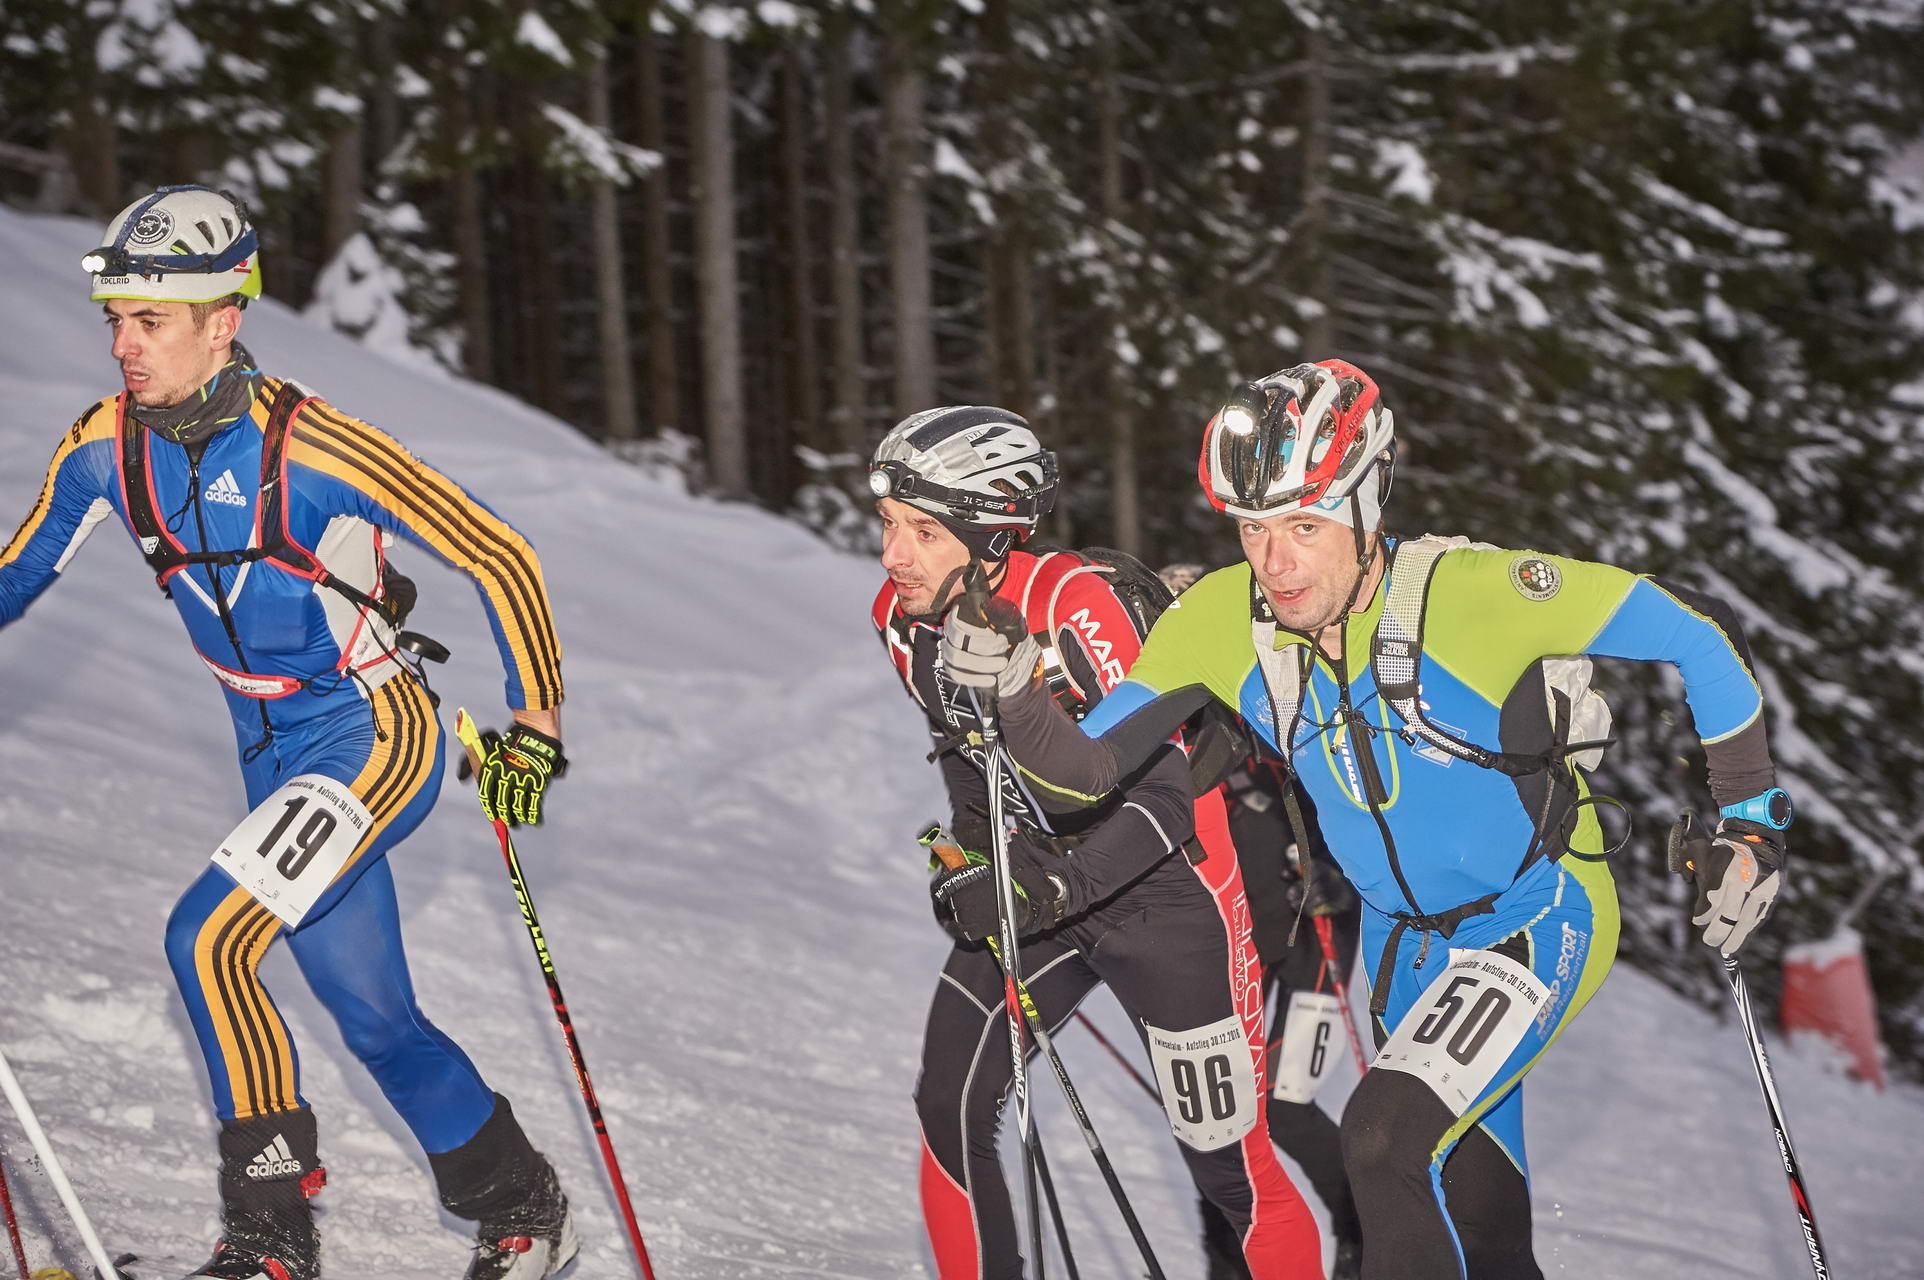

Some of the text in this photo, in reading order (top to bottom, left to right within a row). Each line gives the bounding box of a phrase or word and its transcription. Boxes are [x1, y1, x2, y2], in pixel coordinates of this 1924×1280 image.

[205, 490, 247, 507] adidas
[520, 735, 557, 758] LEKI
[255, 795, 337, 881] 19
[1232, 898, 1246, 1001] COMPETITION
[1557, 922, 1579, 982] SPORT
[1481, 962, 1508, 982] Aufstieg
[1507, 973, 1538, 1005] 30.12.2016
[1186, 1039, 1210, 1052] Aufstieg
[1210, 1028, 1241, 1048] 30.12.2016
[1310, 1021, 1331, 1078] 6
[1412, 976, 1512, 1066] 50
[1009, 1015, 1025, 1099] DYNAFIT
[1171, 1054, 1236, 1124] 96
[246, 1159, 302, 1178] adidas
